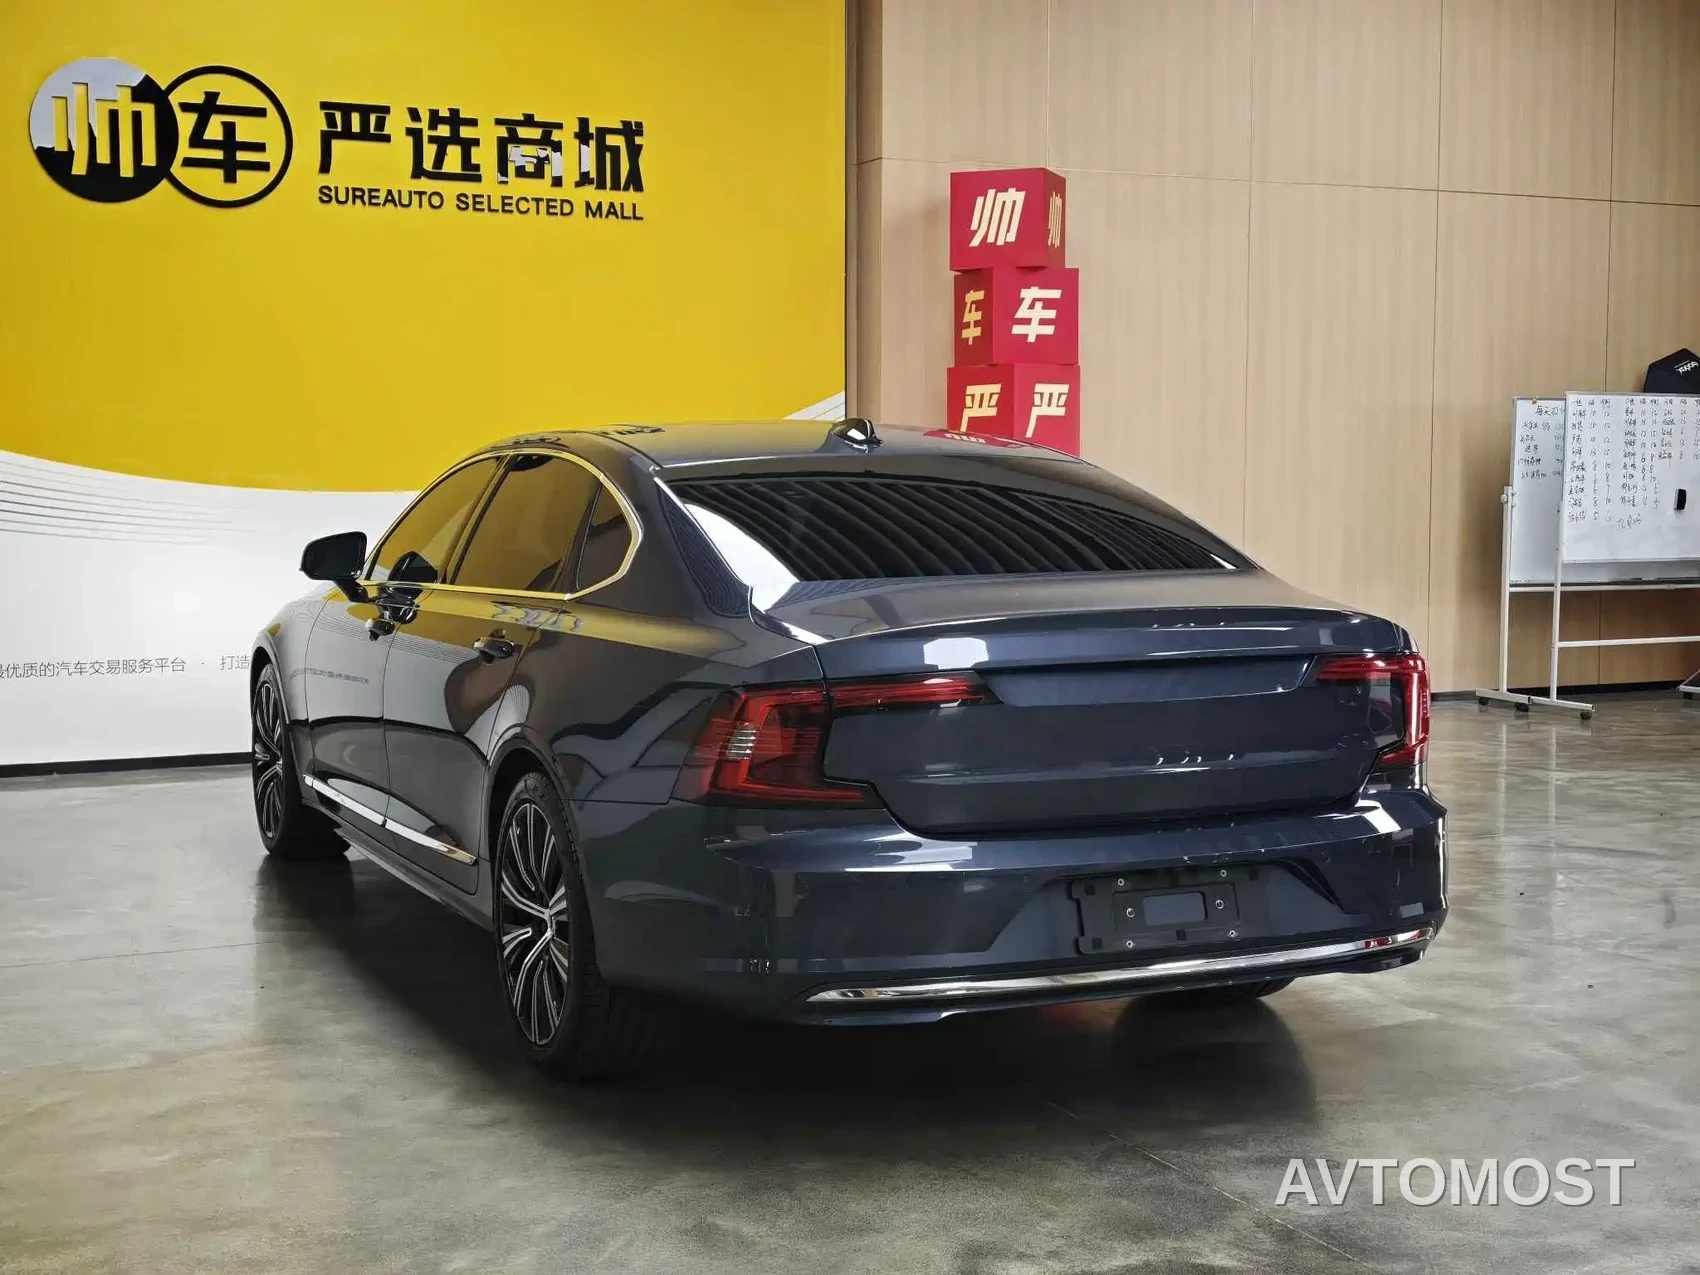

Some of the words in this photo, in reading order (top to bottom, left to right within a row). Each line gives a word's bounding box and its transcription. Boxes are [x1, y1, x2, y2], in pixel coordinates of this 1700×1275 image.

[318, 101, 645, 192] 严选商城
[318, 185, 445, 210] SUREAUTO
[455, 193, 574, 217] SELECTED
[584, 200, 644, 221] MALL
[969, 187, 1026, 247] 帅
[961, 289, 985, 346] 车
[1011, 286, 1063, 343] 车
[960, 383, 1002, 434] 严
[1025, 383, 1070, 438] 严
